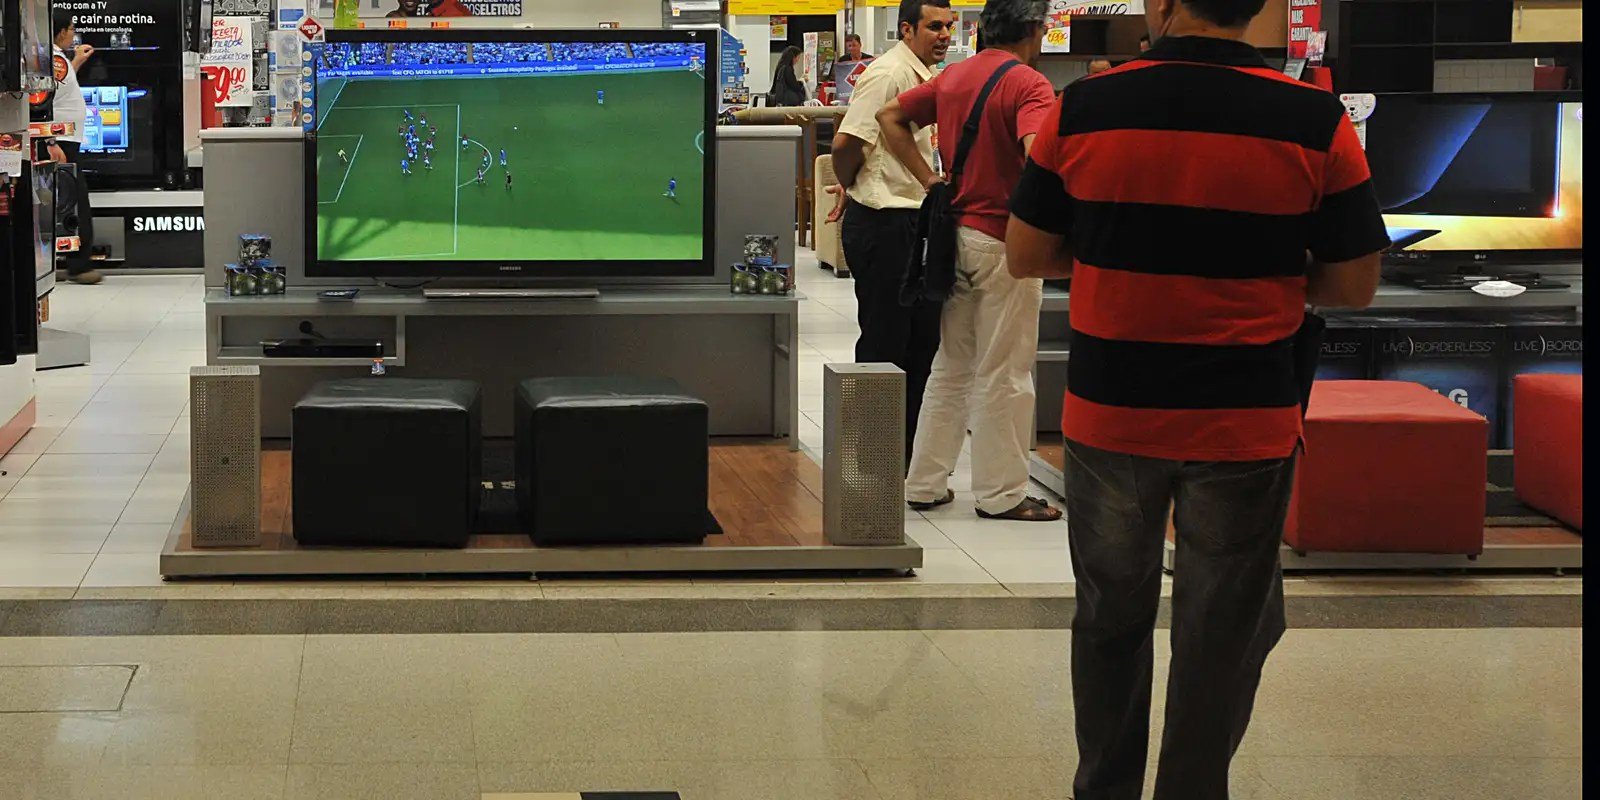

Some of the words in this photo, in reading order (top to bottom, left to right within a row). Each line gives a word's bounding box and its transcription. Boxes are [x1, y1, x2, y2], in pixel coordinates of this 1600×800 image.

[97, 1, 107, 9] TV
[72, 15, 78, 24] e
[80, 13, 102, 24] cair
[104, 15, 117, 24] na
[119, 13, 156, 24] rotina.
[133, 216, 205, 231] SAMSUN
[1514, 341, 1539, 351] LIVE
